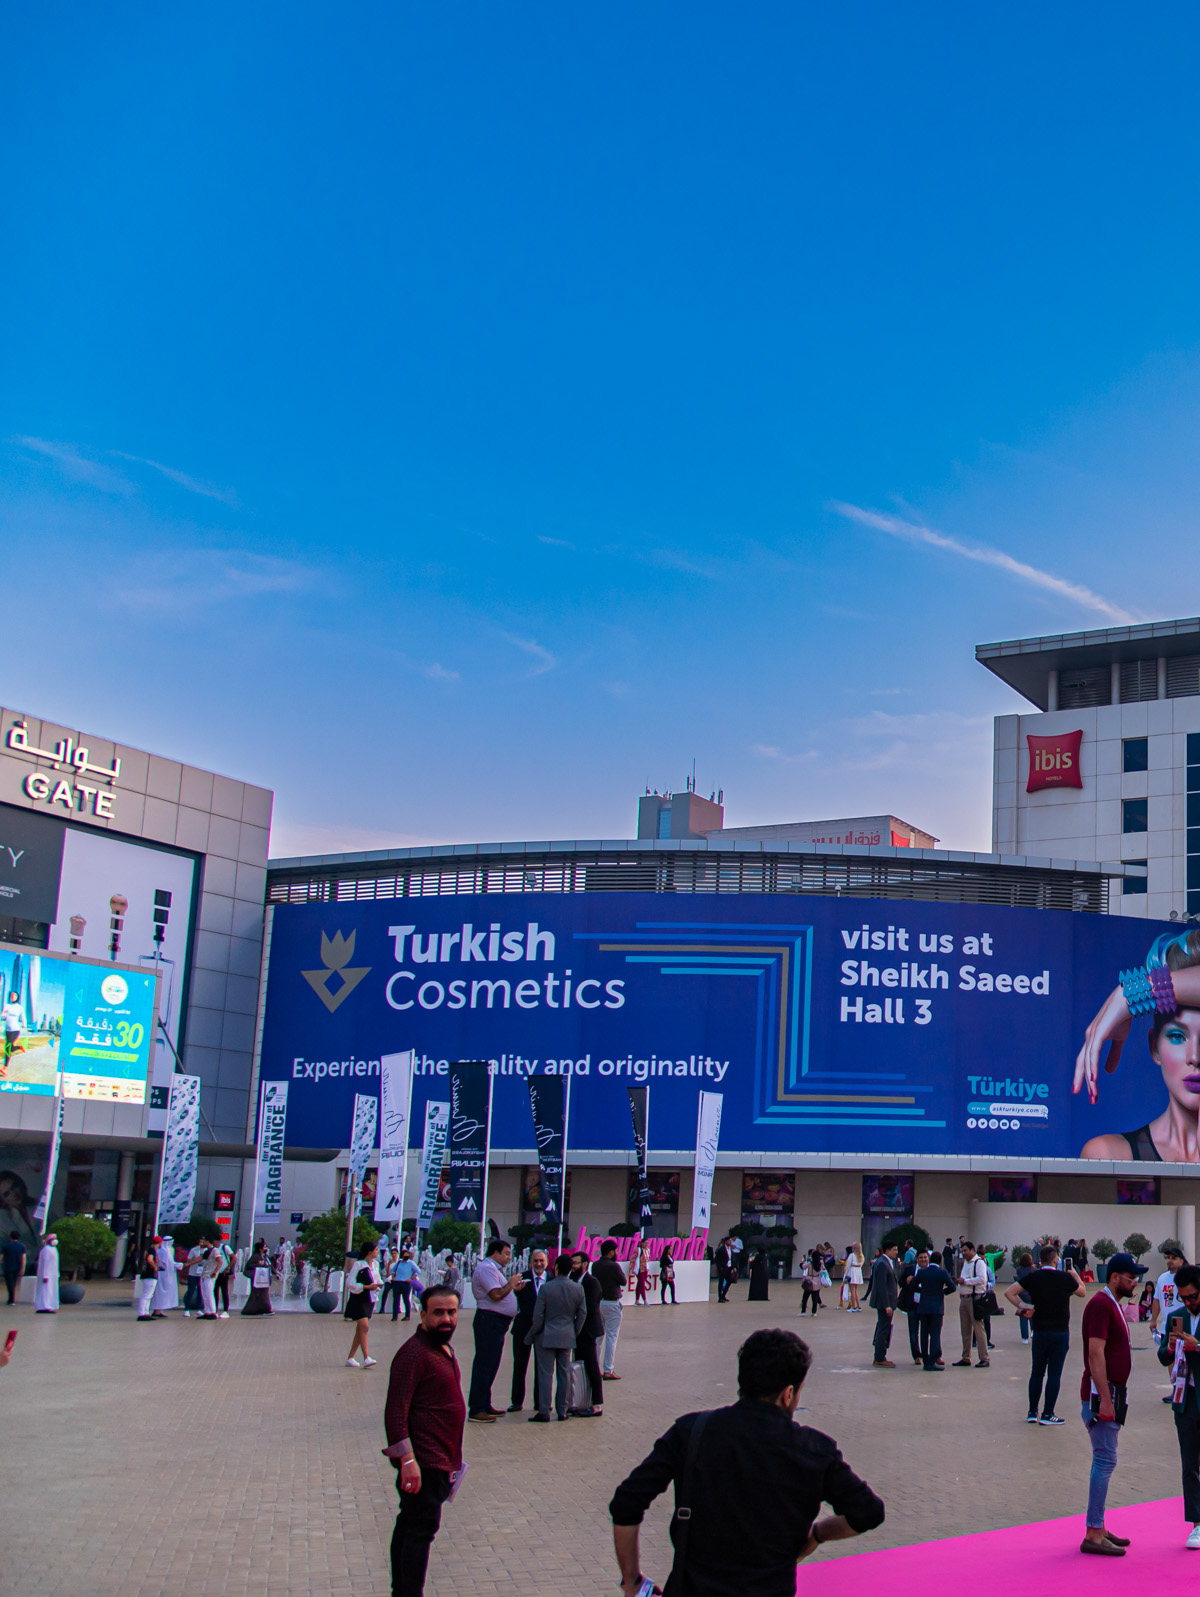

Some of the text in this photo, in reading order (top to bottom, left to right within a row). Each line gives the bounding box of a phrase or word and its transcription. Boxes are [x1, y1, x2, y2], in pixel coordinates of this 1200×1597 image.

[8, 721, 121, 785] بوابة
[1035, 747, 1073, 772] ibis
[25, 773, 117, 819] GATE
[0, 845, 25, 868] Y
[388, 922, 556, 964] Turkish
[841, 924, 993, 957] visit us at
[385, 970, 627, 1011] Cosmetics
[840, 960, 1050, 996] Sheikh Saeed
[840, 997, 933, 1026] Hall 3
[74, 1032, 112, 1047] فقط
[76, 1015, 144, 1049] 30 دقيقة
[292, 1054, 730, 1083] Experien the ality and originality
[967, 1076, 1049, 1102] Türkiye
[992, 1105, 1040, 1114] askturkiye.com
[262, 1104, 272, 1162] for the love of
[427, 1132, 435, 1147] love
[264, 1104, 286, 1214] FRAGRANCE
[419, 1122, 448, 1220] FRAGRANCE
[574, 1226, 709, 1262] beutworld
[628, 1273, 660, 1293] EST
